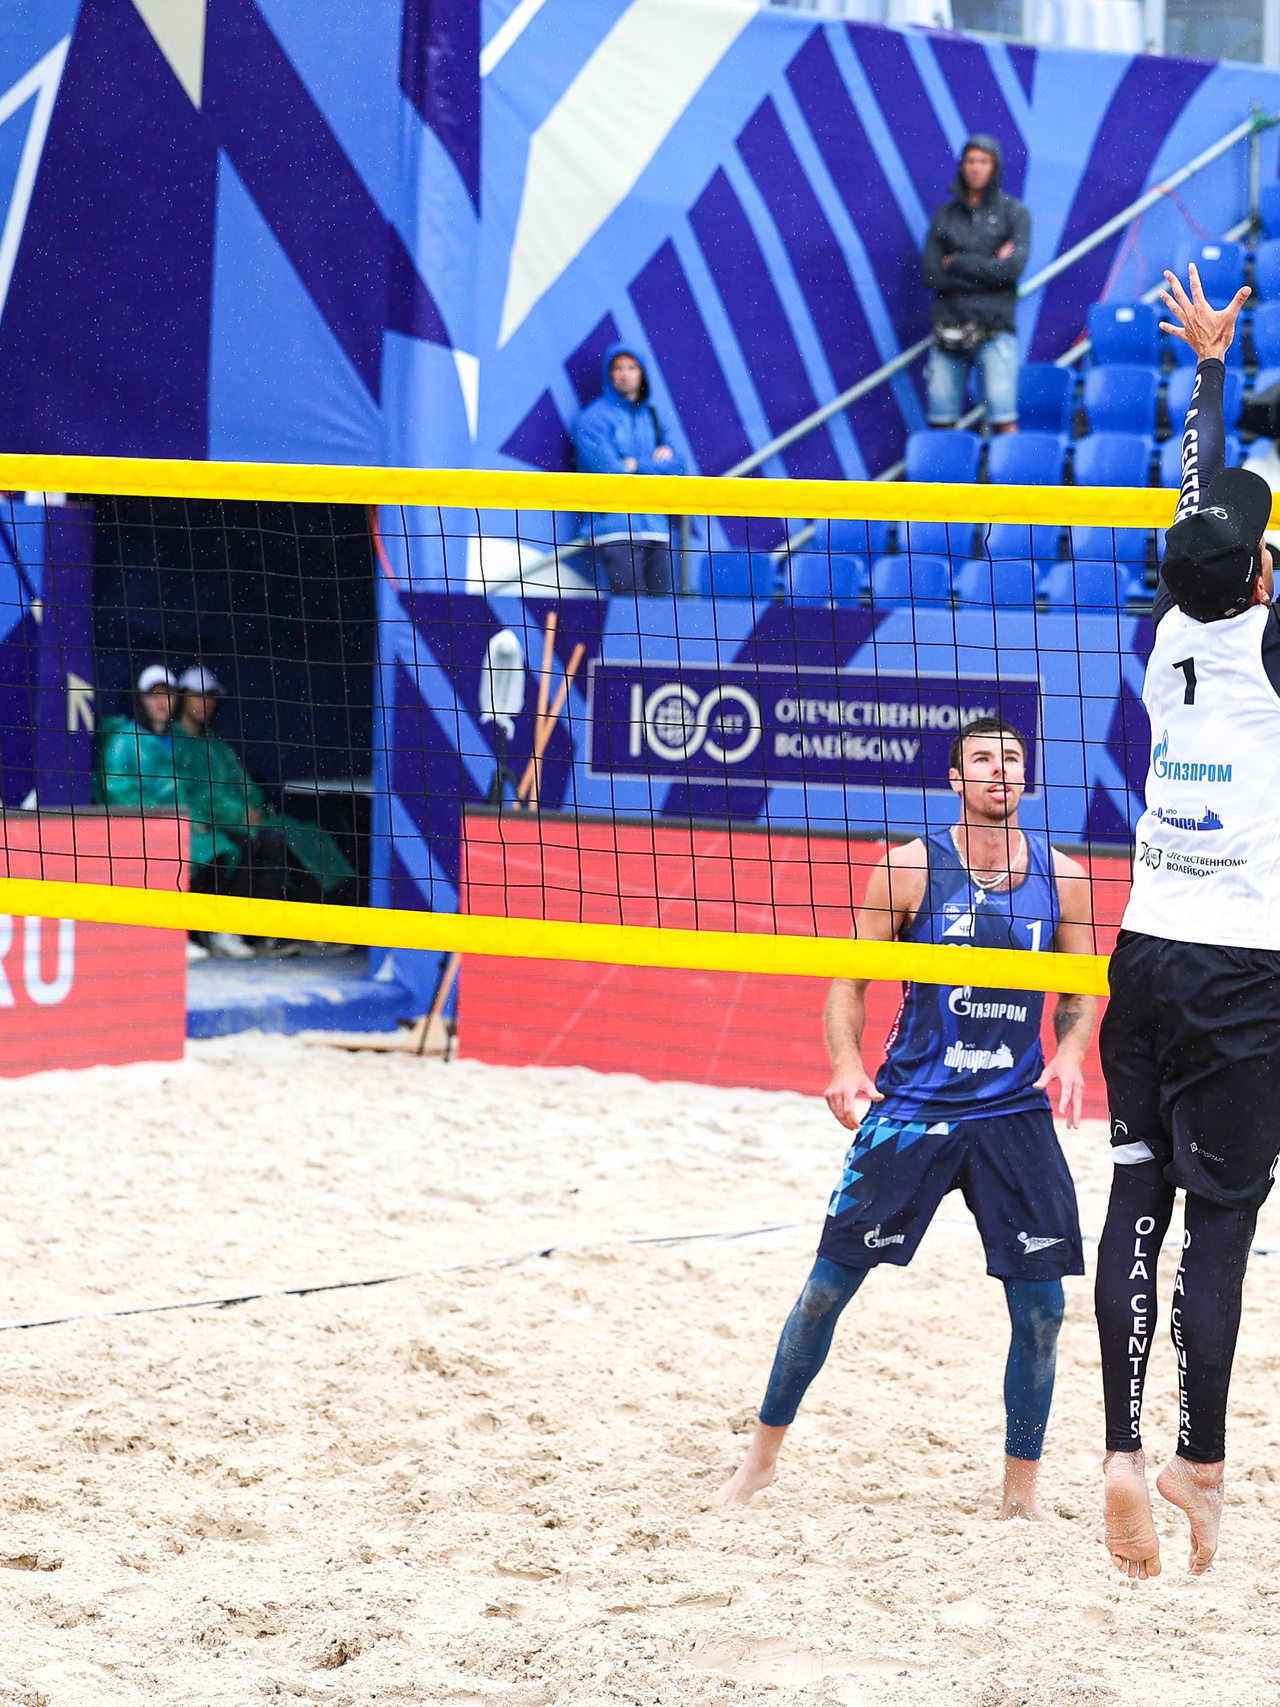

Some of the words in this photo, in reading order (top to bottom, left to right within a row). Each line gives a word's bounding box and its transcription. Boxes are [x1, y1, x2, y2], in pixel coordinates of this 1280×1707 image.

[1172, 657, 1197, 705] 1
[629, 683, 761, 764] 100
[774, 732, 920, 764] ВОЛЕЙБОЛУ
[1167, 762, 1233, 782] ГАЗПРОМ
[1026, 920, 1042, 952] 1
[970, 1003, 1027, 1022] ГАЗПРОМ
[1129, 1216, 1155, 1280] OLA
[1128, 1294, 1148, 1438] CENTERS
[1172, 1308, 1192, 1446] CENTERS
